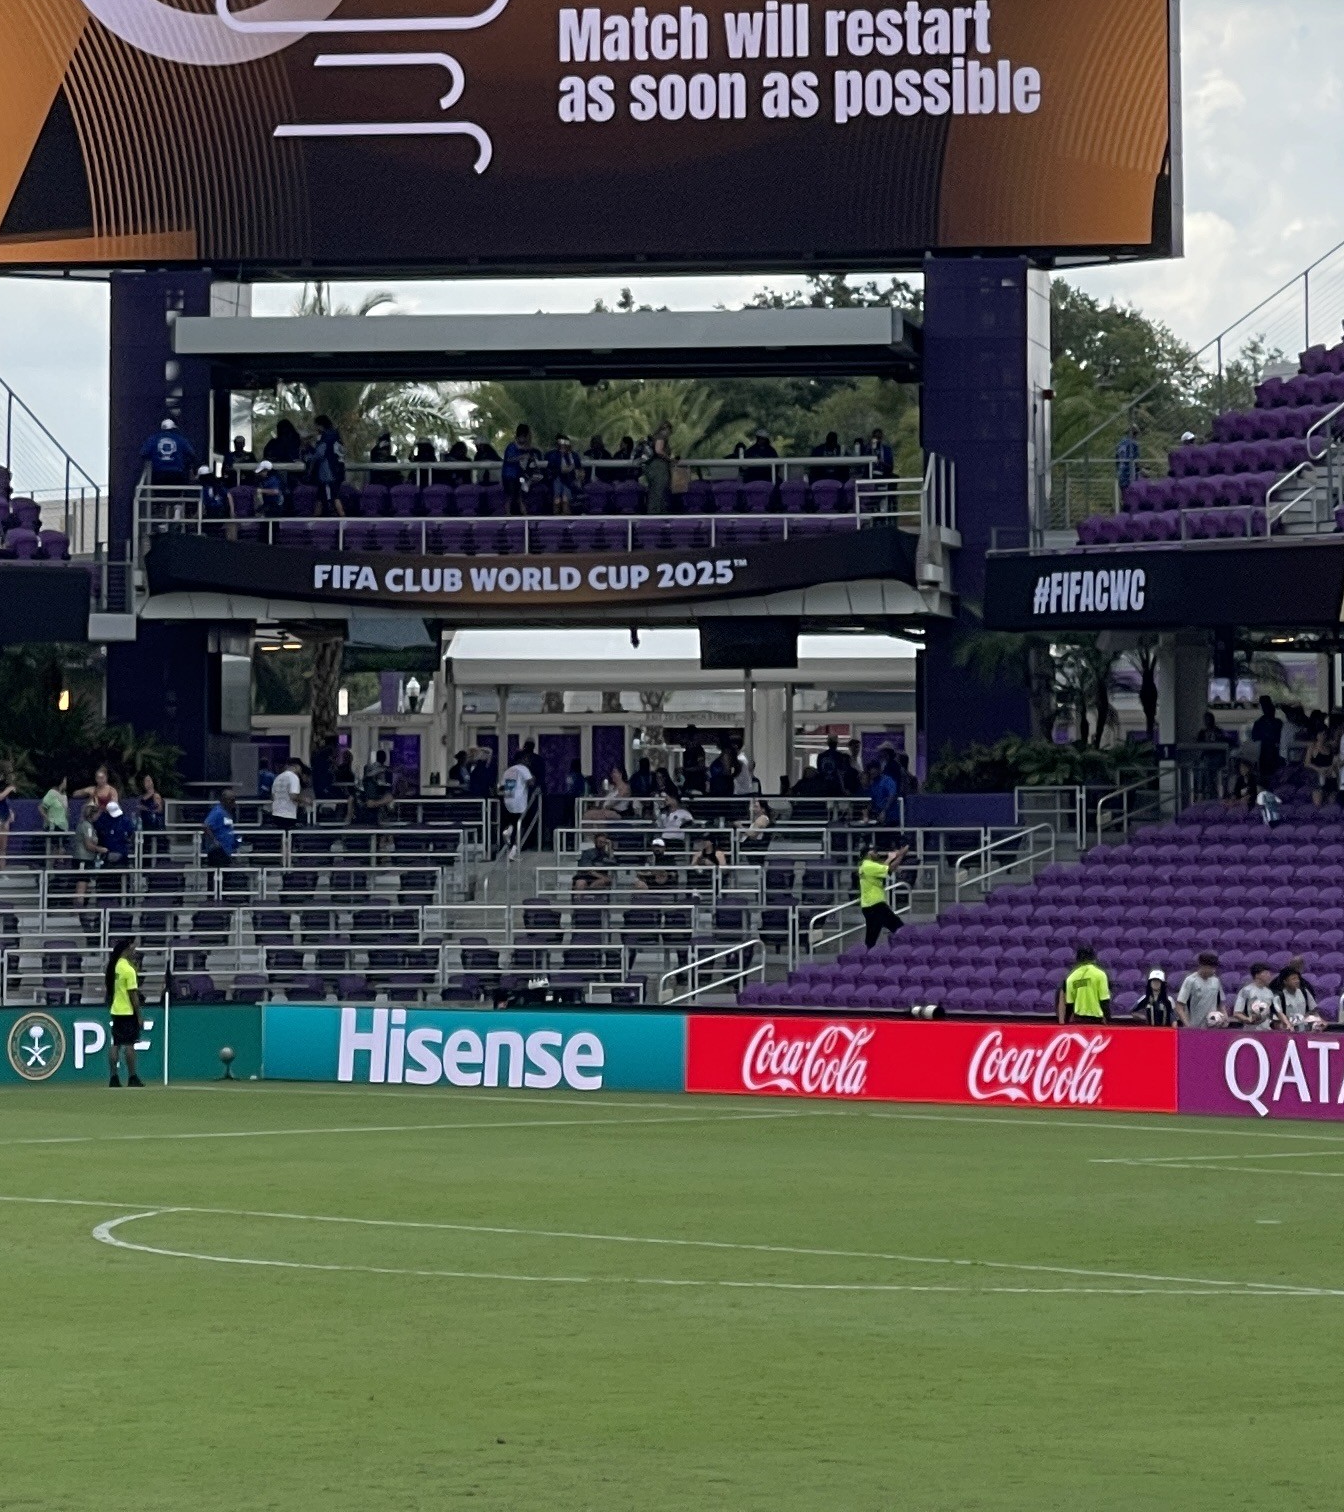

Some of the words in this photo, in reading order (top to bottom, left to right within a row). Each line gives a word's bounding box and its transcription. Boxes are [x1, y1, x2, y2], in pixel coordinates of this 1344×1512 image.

[559, 6, 709, 62] Match
[724, 0, 809, 59] will
[825, 0, 991, 56] restart
[558, 74, 615, 122] as
[629, 72, 747, 120] soon
[762, 71, 819, 119] as
[834, 59, 1041, 124] possible
[314, 564, 378, 590] FIFA
[385, 568, 463, 592] CLUB
[470, 566, 582, 592] WORLD
[587, 565, 650, 590] CUP
[1033, 568, 1146, 614] #FIFACWC
[337, 1008, 605, 1090] Hisense
